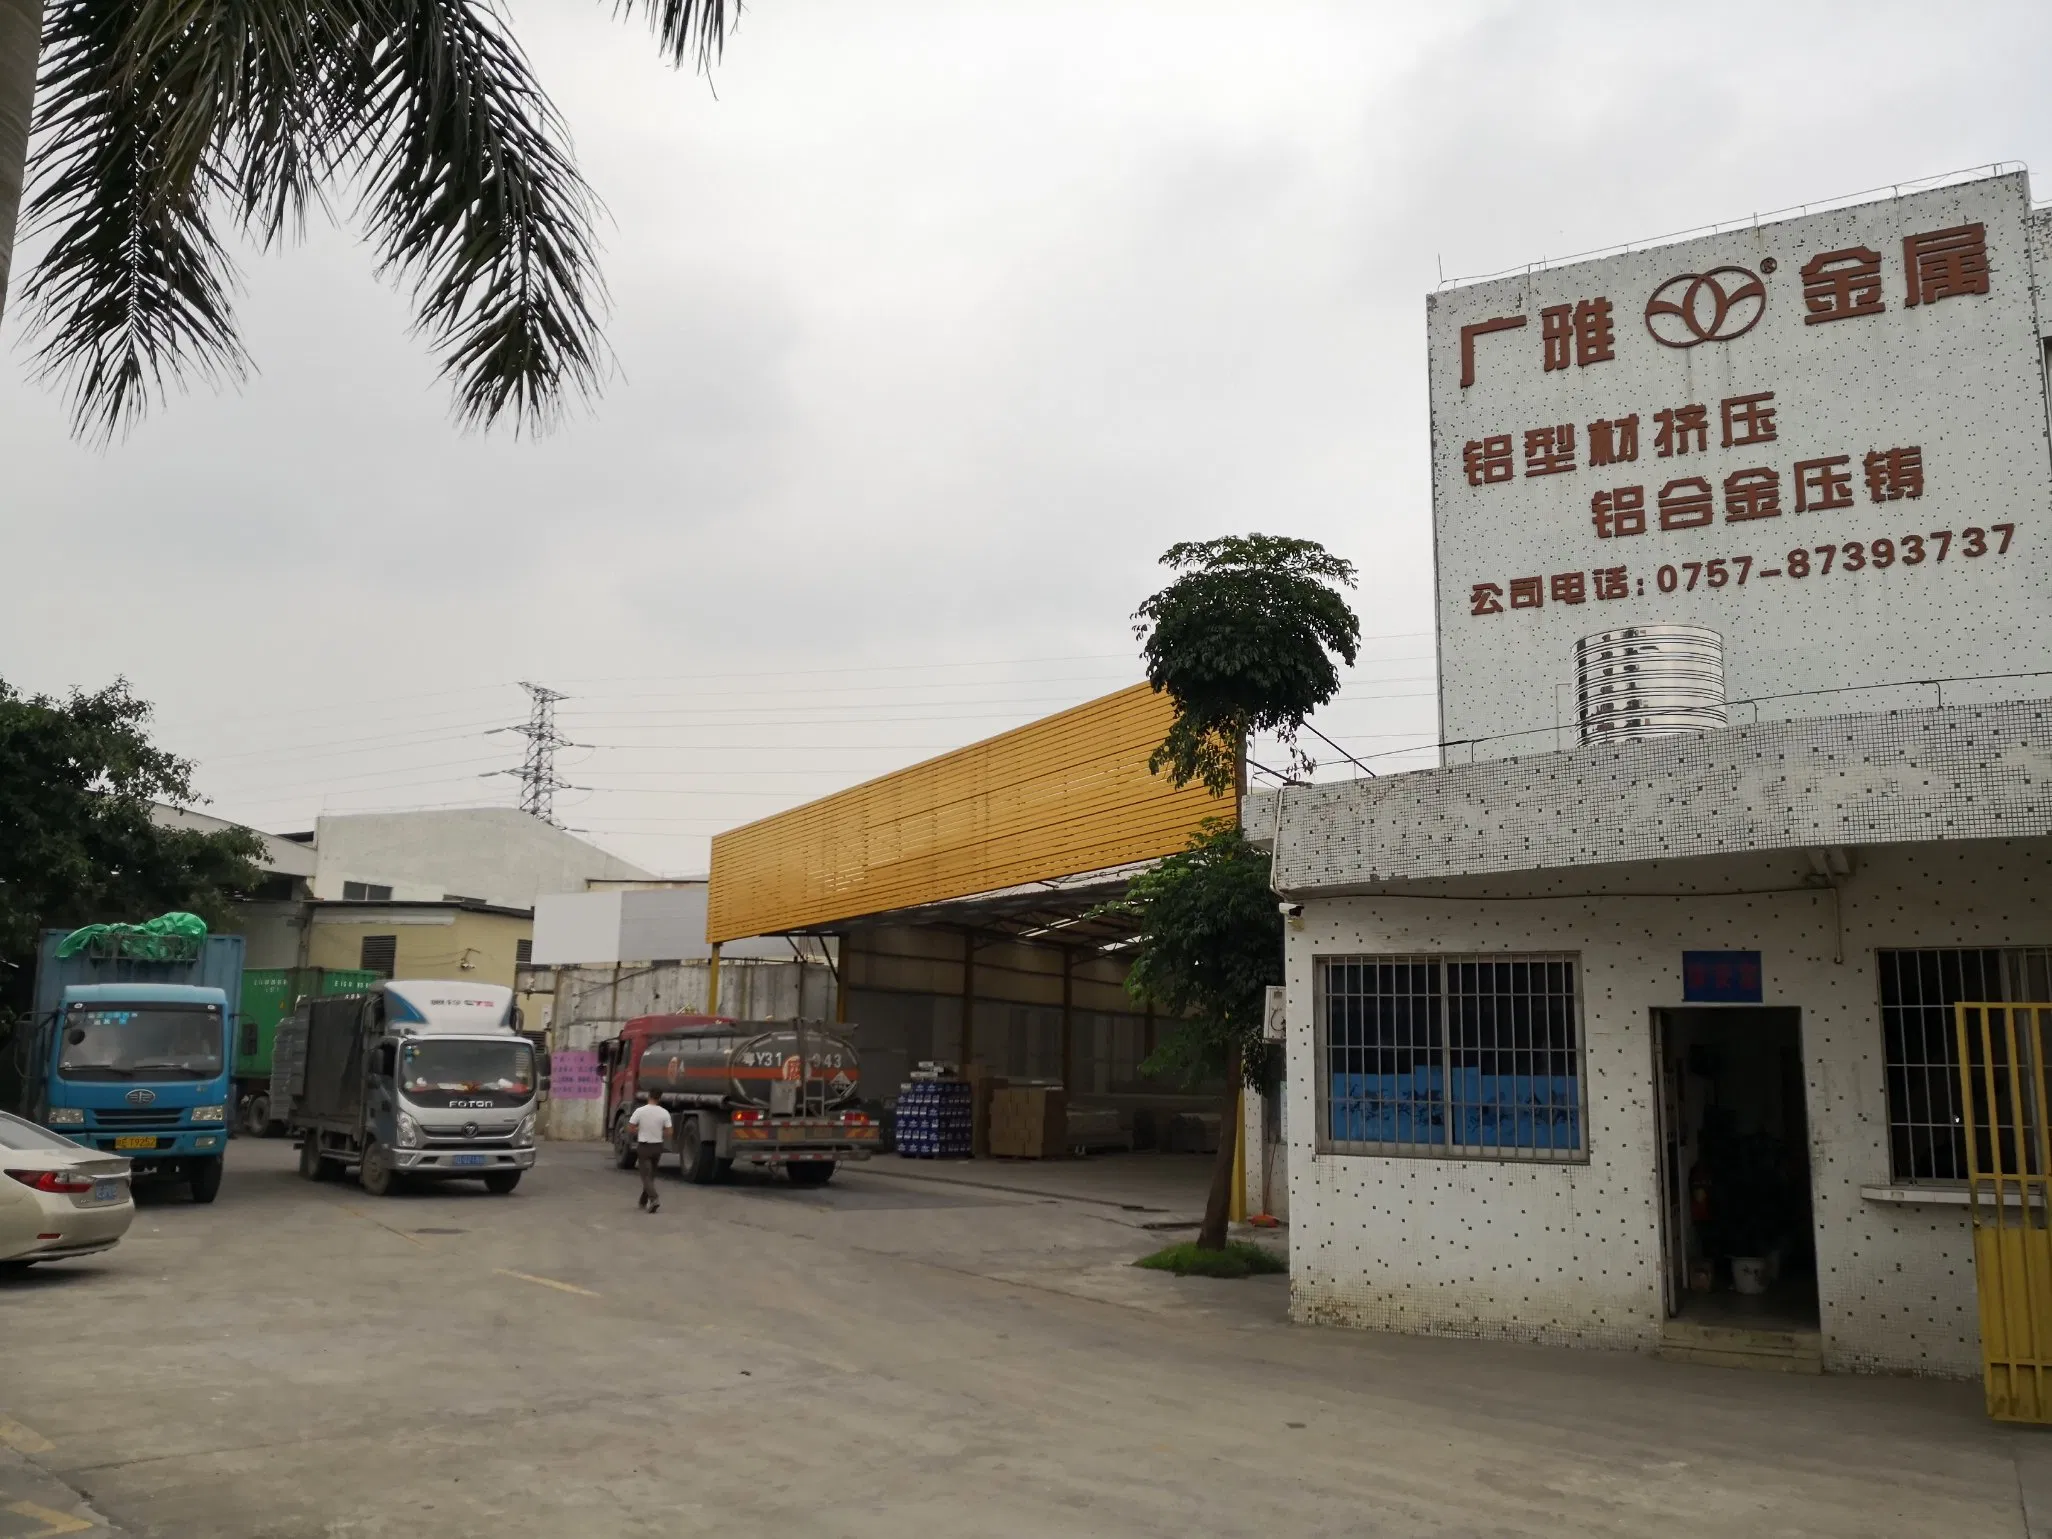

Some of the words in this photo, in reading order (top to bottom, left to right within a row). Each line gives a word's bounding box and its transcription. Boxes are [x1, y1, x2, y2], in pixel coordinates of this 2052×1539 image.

[1459, 296, 1617, 389] 广雅
[1800, 222, 1991, 326] 金属
[1462, 391, 1778, 487] 铝型材挤压
[1591, 446, 1926, 539] 铝合金压铸
[448, 1100, 494, 1108] FOTON
